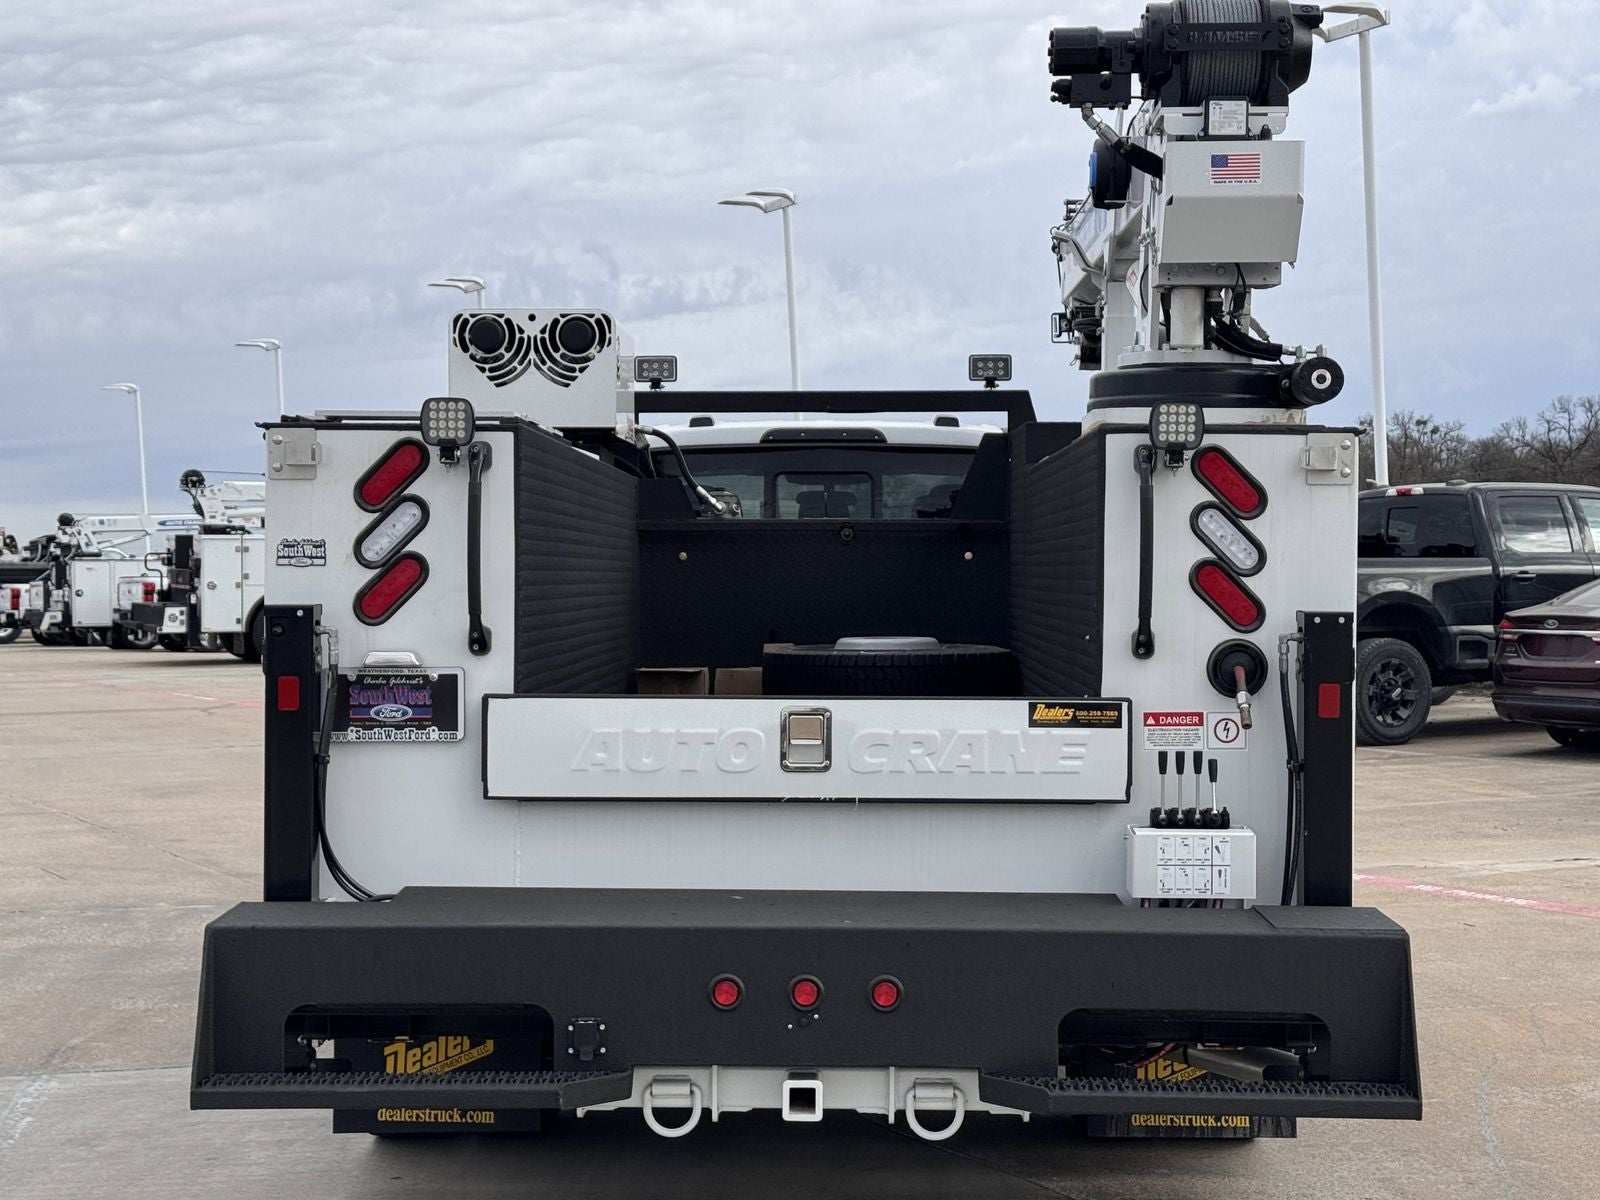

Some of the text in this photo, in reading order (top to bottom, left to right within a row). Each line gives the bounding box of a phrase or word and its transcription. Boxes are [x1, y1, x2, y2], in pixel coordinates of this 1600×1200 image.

[278, 544, 325, 557] SouthWest
[349, 685, 432, 705] SouthWest
[379, 707, 403, 718] Ford
[1032, 704, 1075, 719] Dealers
[1160, 716, 1200, 724] DANGER
[570, 728, 1091, 774] AUTO CRANE
[377, 1108, 495, 1123] dealerstruck.com
[1131, 1114, 1250, 1127] dealerstruck.com
